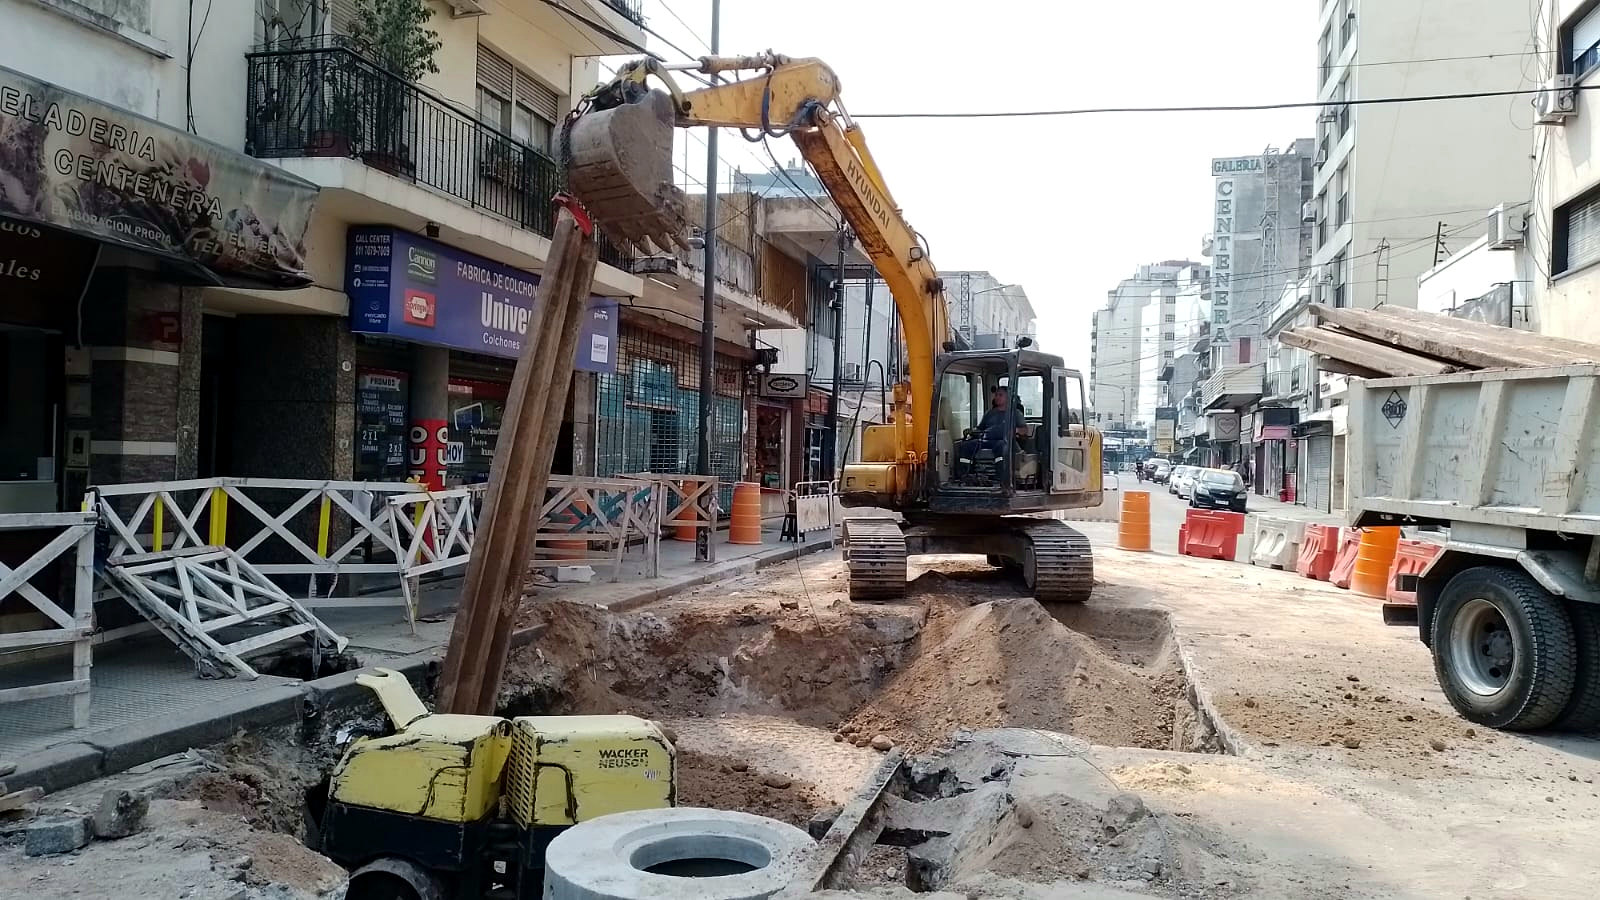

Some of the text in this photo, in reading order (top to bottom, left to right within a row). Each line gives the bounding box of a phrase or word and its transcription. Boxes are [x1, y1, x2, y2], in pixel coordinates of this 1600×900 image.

[1213, 159, 1262, 173] GALERIA
[54, 148, 223, 220] CENTENERA
[846, 159, 890, 229] HYUNDAI
[134, 226, 172, 244] PROPIA
[355, 234, 391, 244] CALL CENTER
[408, 246, 436, 269] Cannon
[1211, 180, 1233, 343] CENTENERA
[457, 261, 492, 286] FABRICA
[493, 272, 503, 289] DE
[483, 332, 520, 350] Colchones
[447, 444, 463, 462] HOY
[599, 748, 649, 759] WACKER
